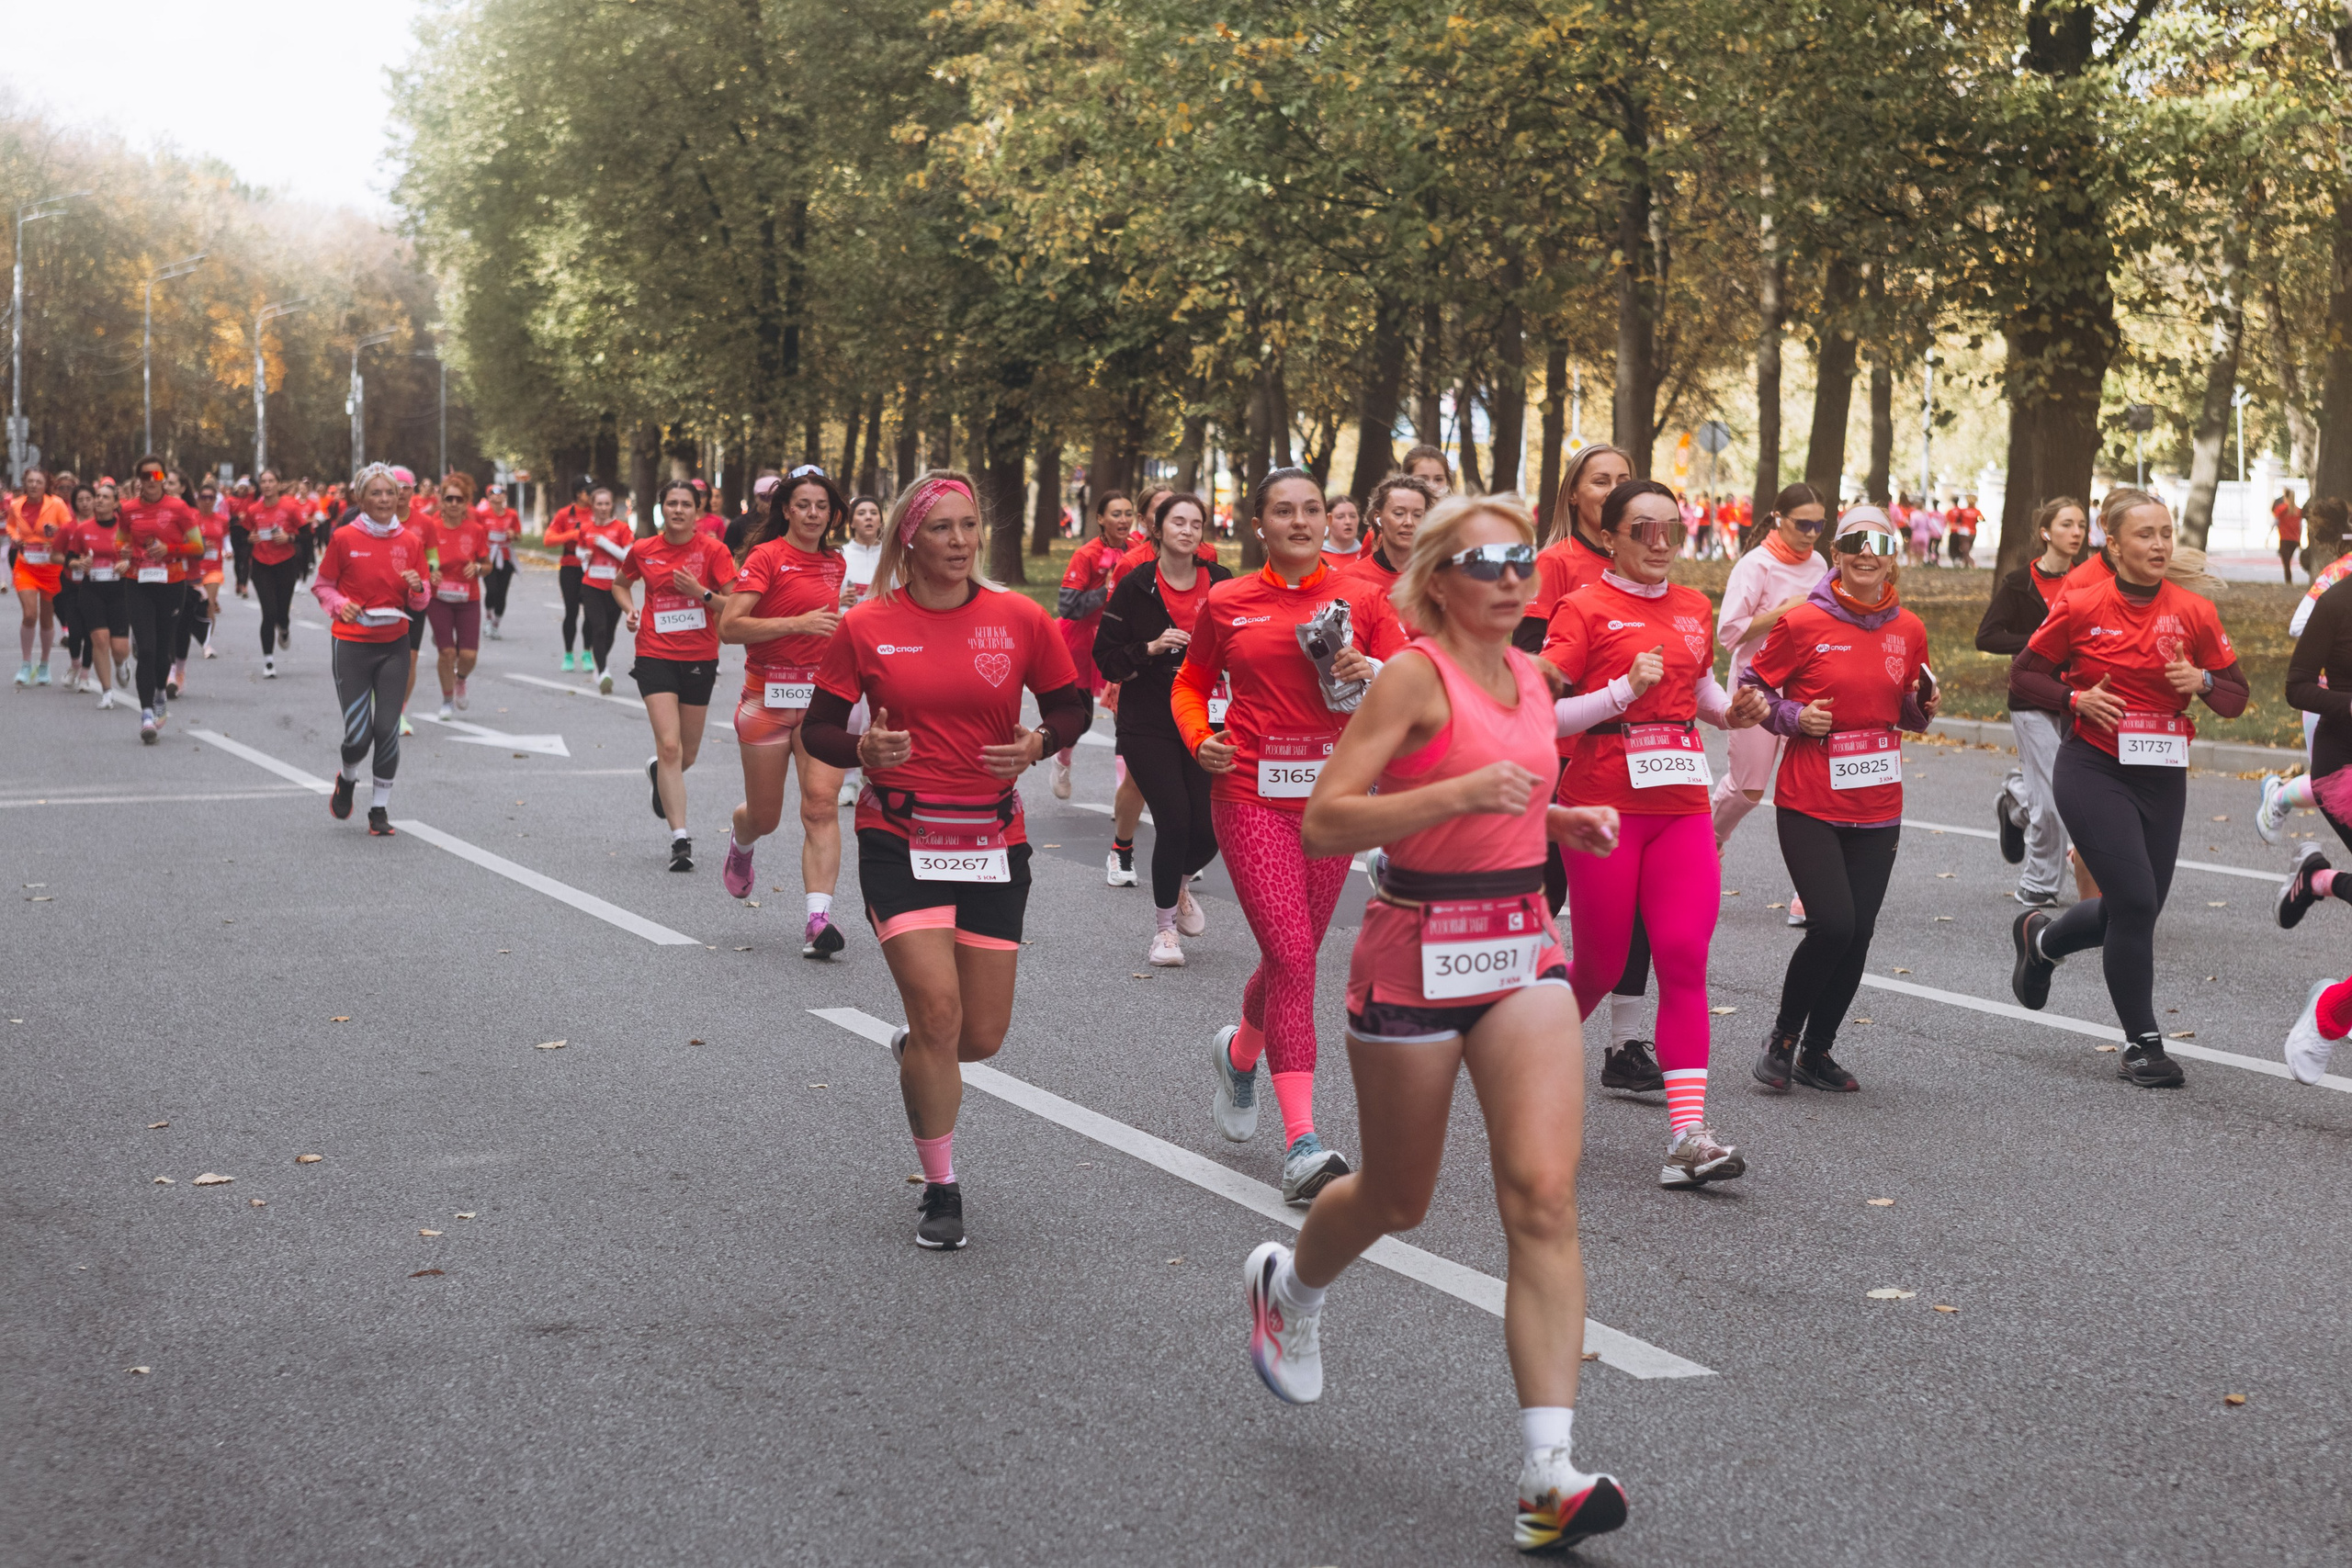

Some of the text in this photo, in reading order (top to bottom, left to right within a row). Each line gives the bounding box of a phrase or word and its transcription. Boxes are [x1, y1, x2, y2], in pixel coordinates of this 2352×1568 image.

[660, 614, 695, 626] 31504
[975, 626, 1008, 638] БЕГИ КАК
[967, 637, 1015, 649] ЧУВСТВУЕШЬ
[771, 688, 812, 699] 31603
[1682, 737, 1690, 745] C
[1880, 738, 1885, 746] B
[2128, 739, 2173, 753] 31737
[1324, 744, 1331, 752] C
[1635, 757, 1696, 773] 30283
[1835, 759, 1889, 777] 30825
[1268, 768, 1319, 783] 3165
[919, 857, 989, 871] 30267
[1510, 915, 1521, 927] C
[1435, 949, 1518, 976] 30081
